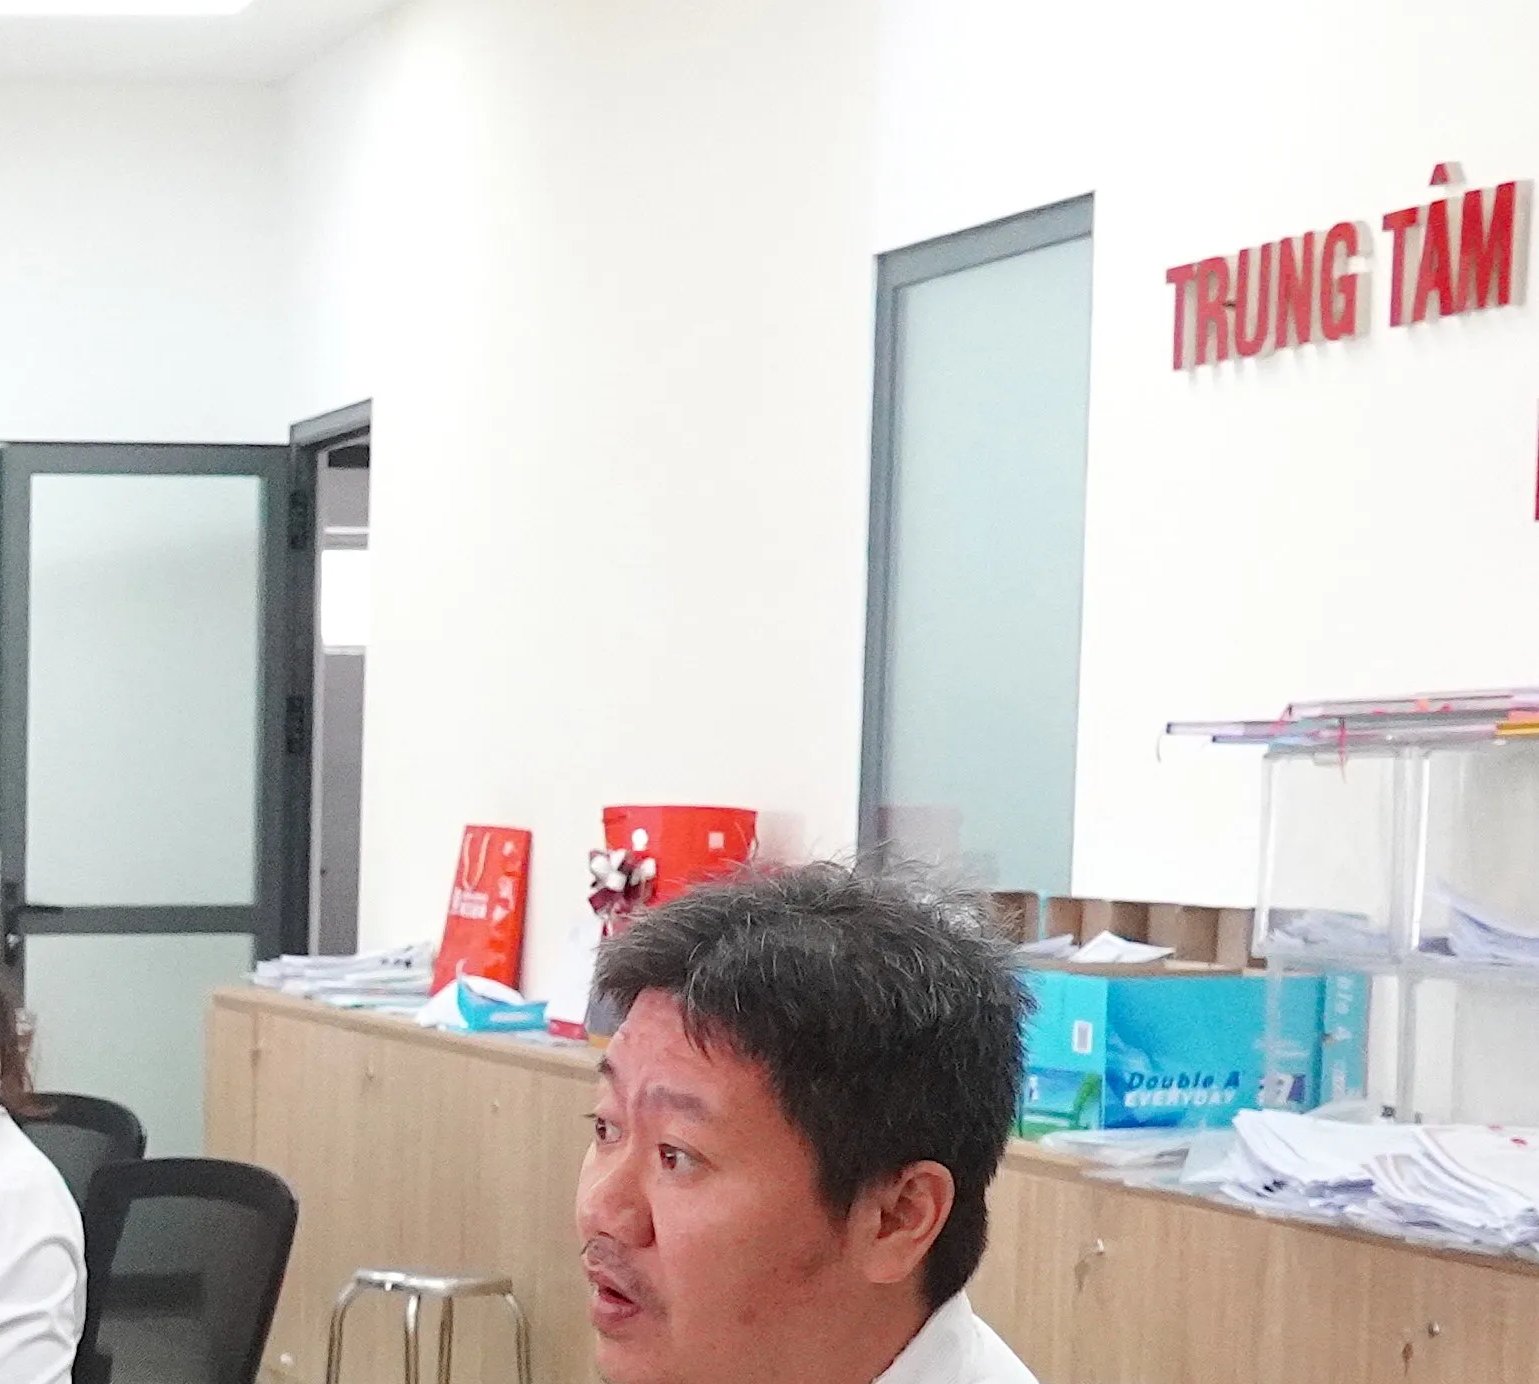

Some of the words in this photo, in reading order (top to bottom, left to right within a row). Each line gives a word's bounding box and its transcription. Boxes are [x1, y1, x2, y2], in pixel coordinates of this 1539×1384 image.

[1165, 221, 1364, 372] TRUNG
[1382, 162, 1519, 328] TÂM
[1124, 1070, 1216, 1090] Double
[1224, 1070, 1241, 1089] A
[1123, 1087, 1238, 1108] EVERYDAY
